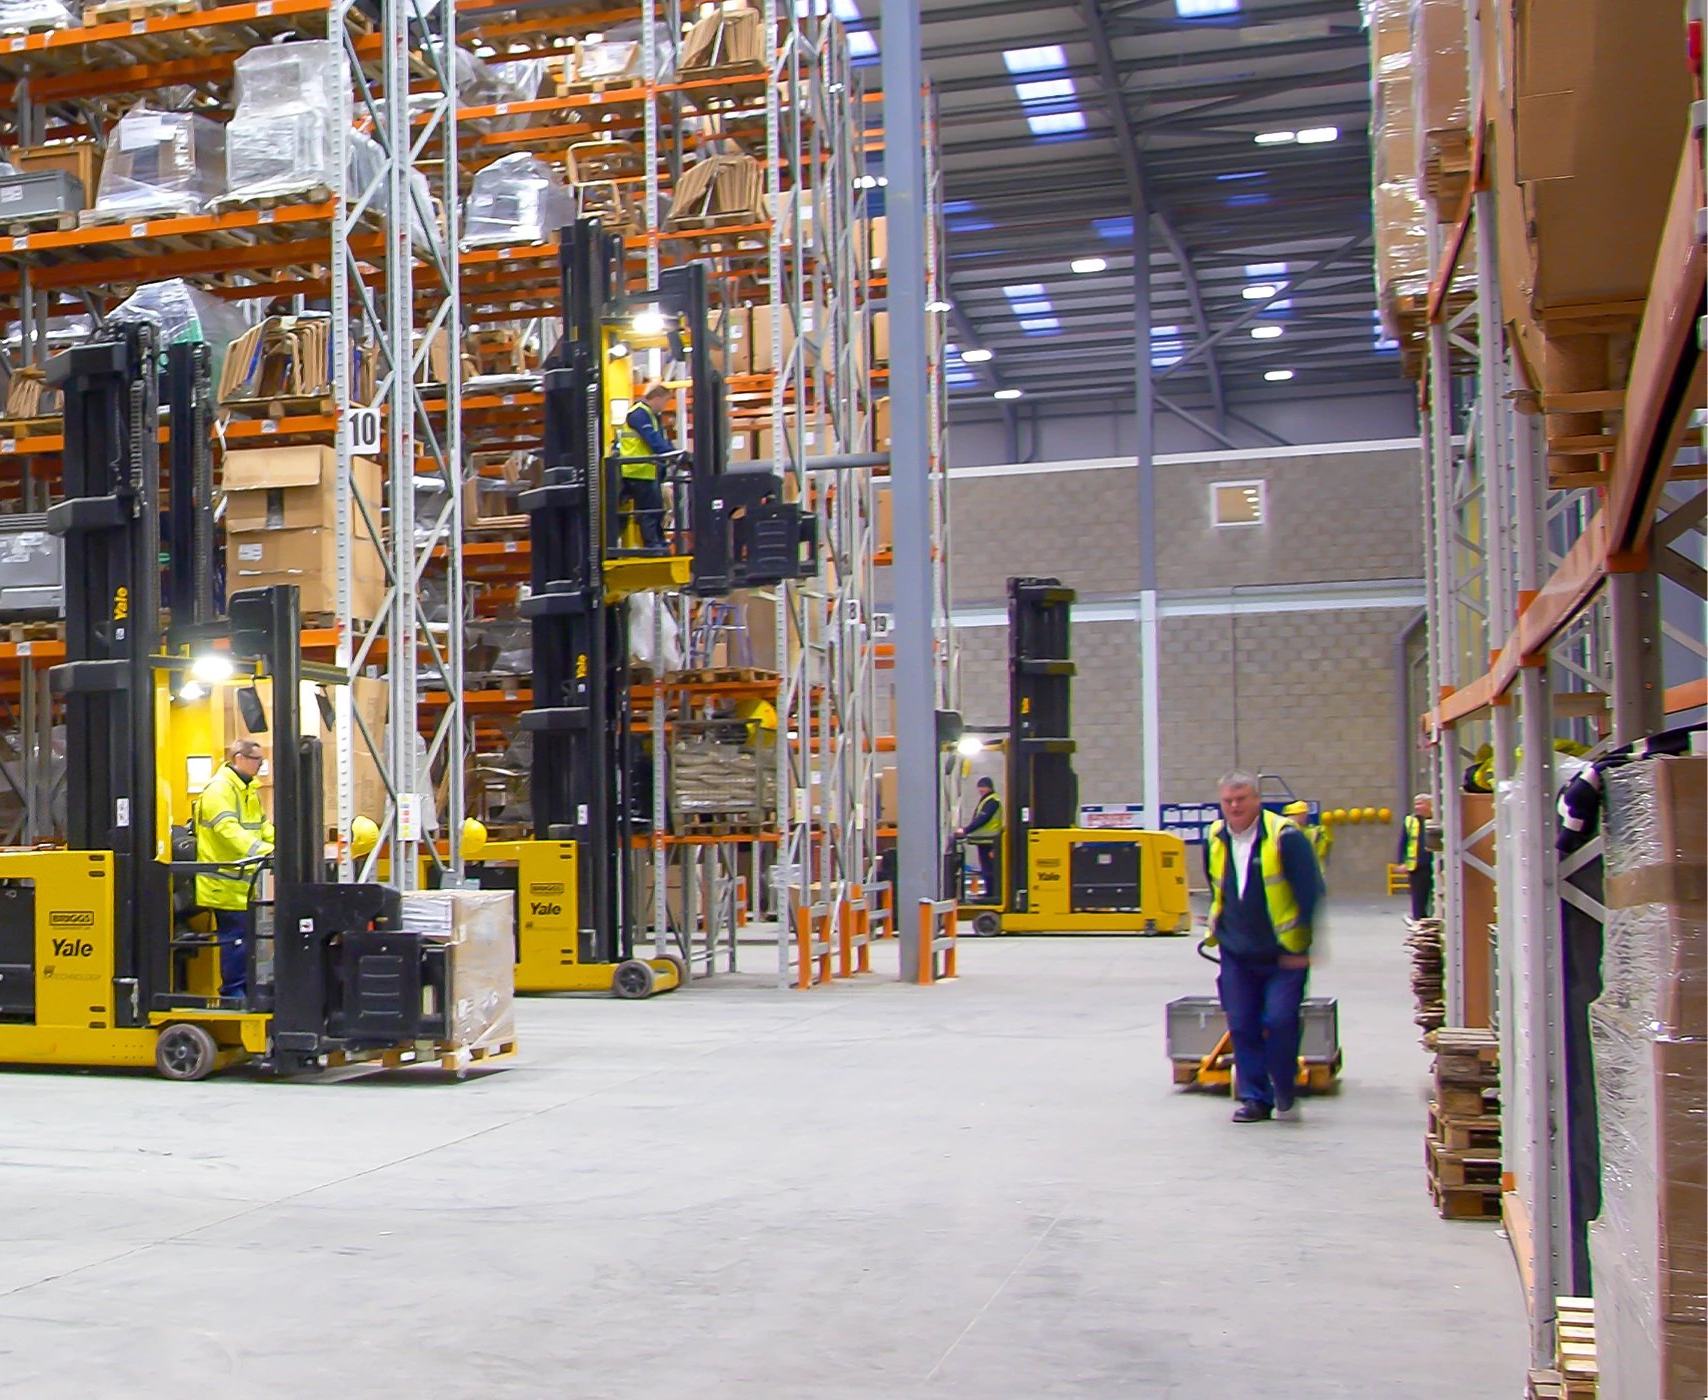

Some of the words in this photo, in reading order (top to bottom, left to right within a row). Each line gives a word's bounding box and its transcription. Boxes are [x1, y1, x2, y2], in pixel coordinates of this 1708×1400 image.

[349, 412, 377, 446] 10
[113, 586, 128, 621] Yale
[873, 615, 887, 632] 19
[530, 902, 562, 916] Yale
[51, 938, 93, 957] Yale
